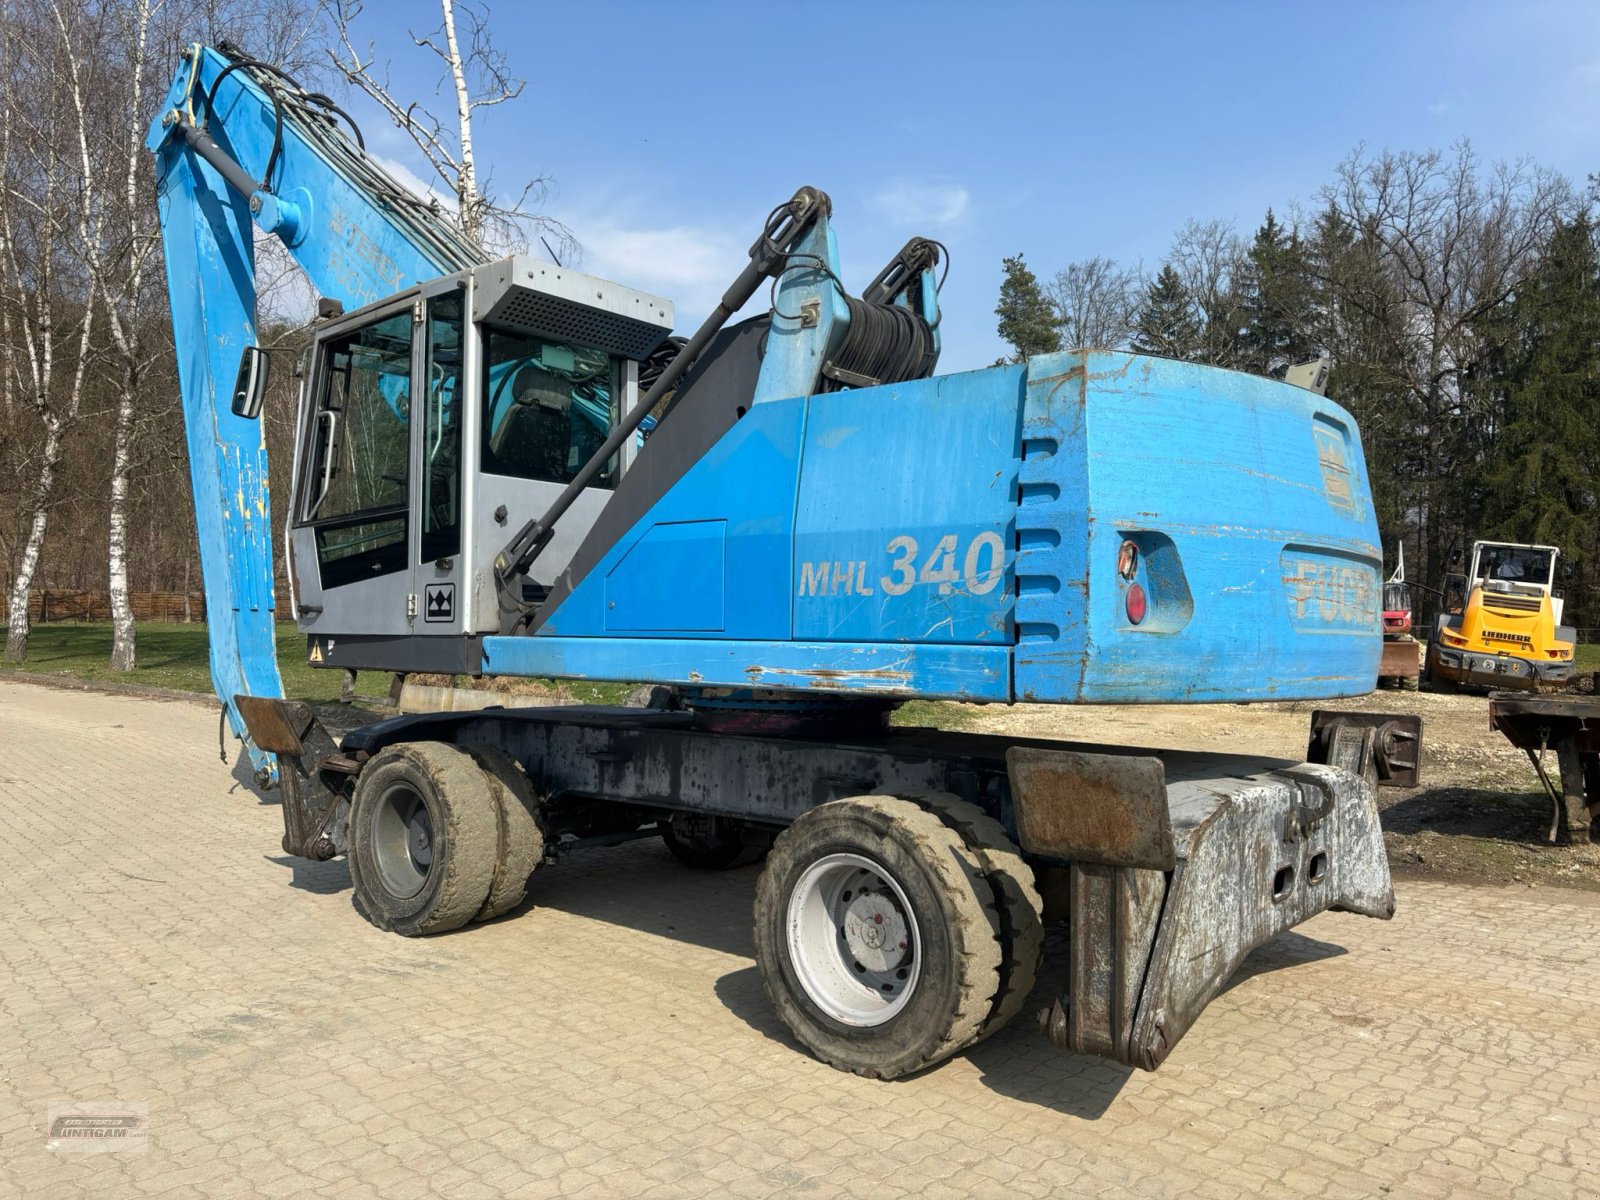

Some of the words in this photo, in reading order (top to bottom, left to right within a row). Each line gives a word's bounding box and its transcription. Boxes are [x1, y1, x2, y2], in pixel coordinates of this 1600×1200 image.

[798, 560, 874, 596] MHL
[880, 530, 1006, 596] 340
[1481, 630, 1532, 643] LIEBHERR
